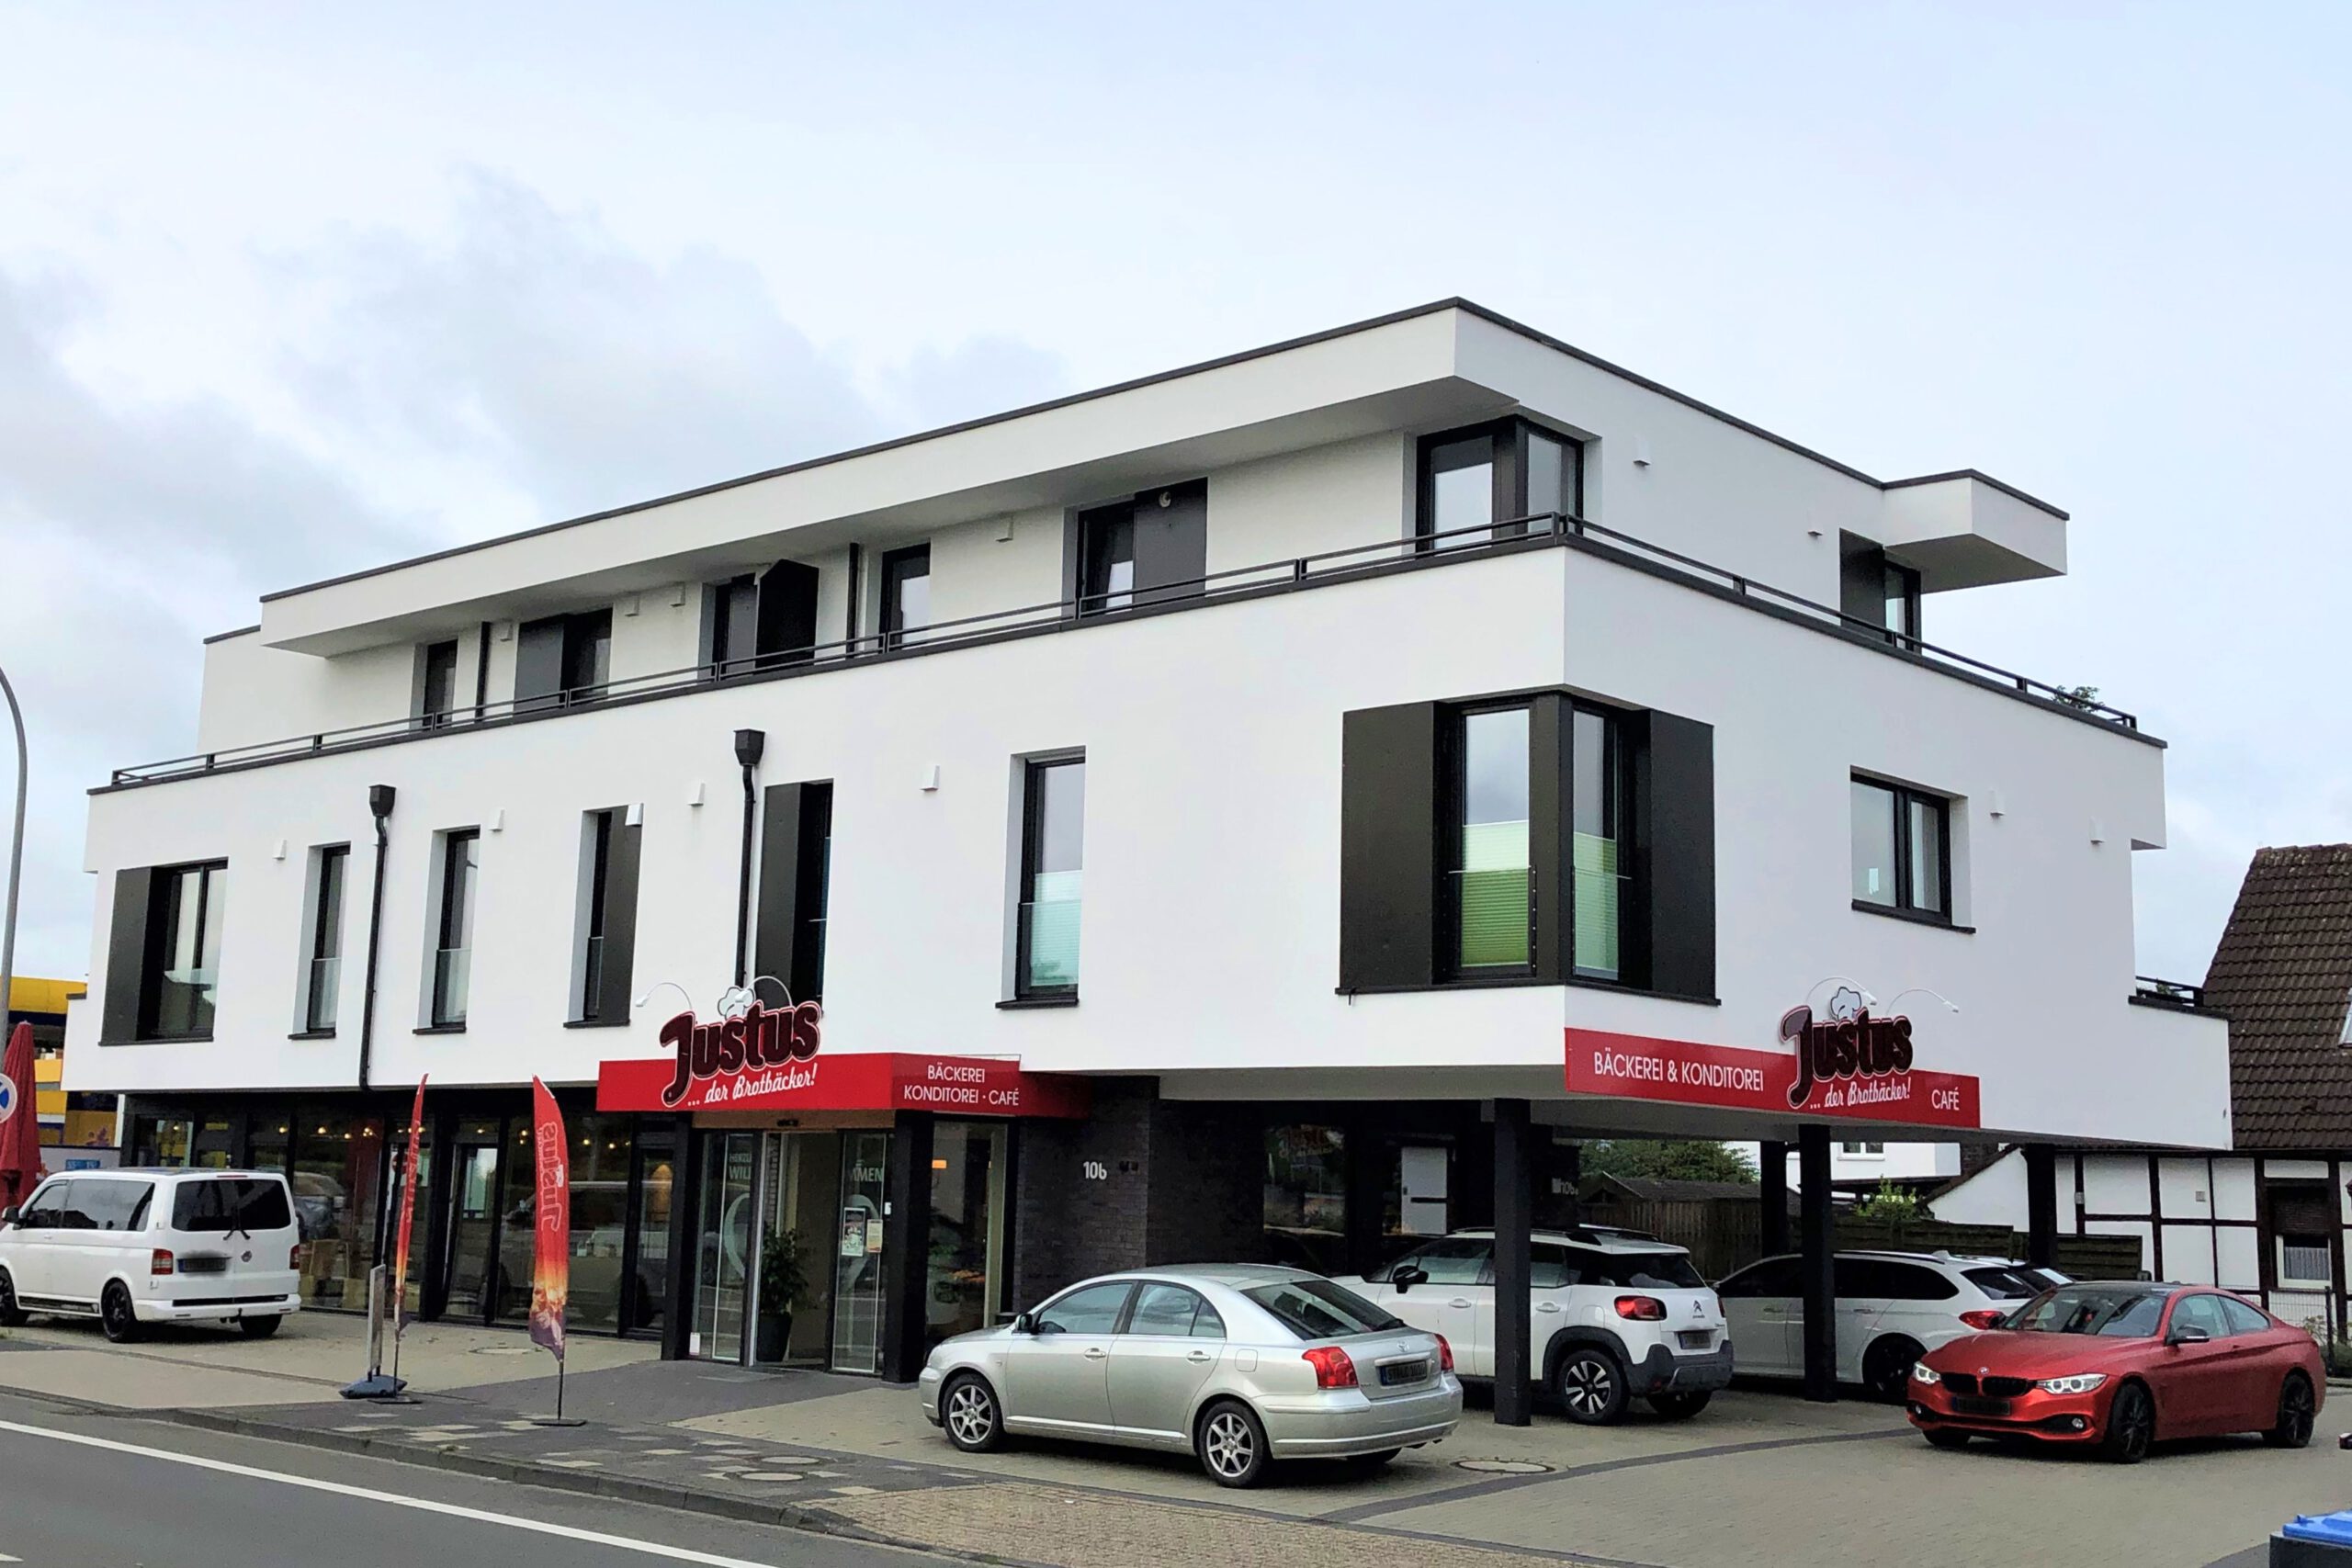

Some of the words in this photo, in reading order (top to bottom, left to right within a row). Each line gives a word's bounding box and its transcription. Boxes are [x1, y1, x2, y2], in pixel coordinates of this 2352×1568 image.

[660, 999, 820, 1108] Justus
[1594, 1047, 1663, 1081] BÄCKEREI
[1668, 1059, 1678, 1083] &
[1681, 1062, 1764, 1092] KONDITOREI
[1781, 1006, 1913, 1109] Justus
[704, 1080, 729, 1103] der
[732, 1062, 818, 1100] Brotbäcker!
[927, 1062, 985, 1083] BÄCKEREI
[904, 1085, 978, 1103] KONDITOREI
[989, 1088, 1019, 1106] CAFÉ
[1824, 1083, 1844, 1108] der
[1848, 1077, 1911, 1107] Brotbäcker!
[1931, 1088, 1960, 1111] CAFÉ
